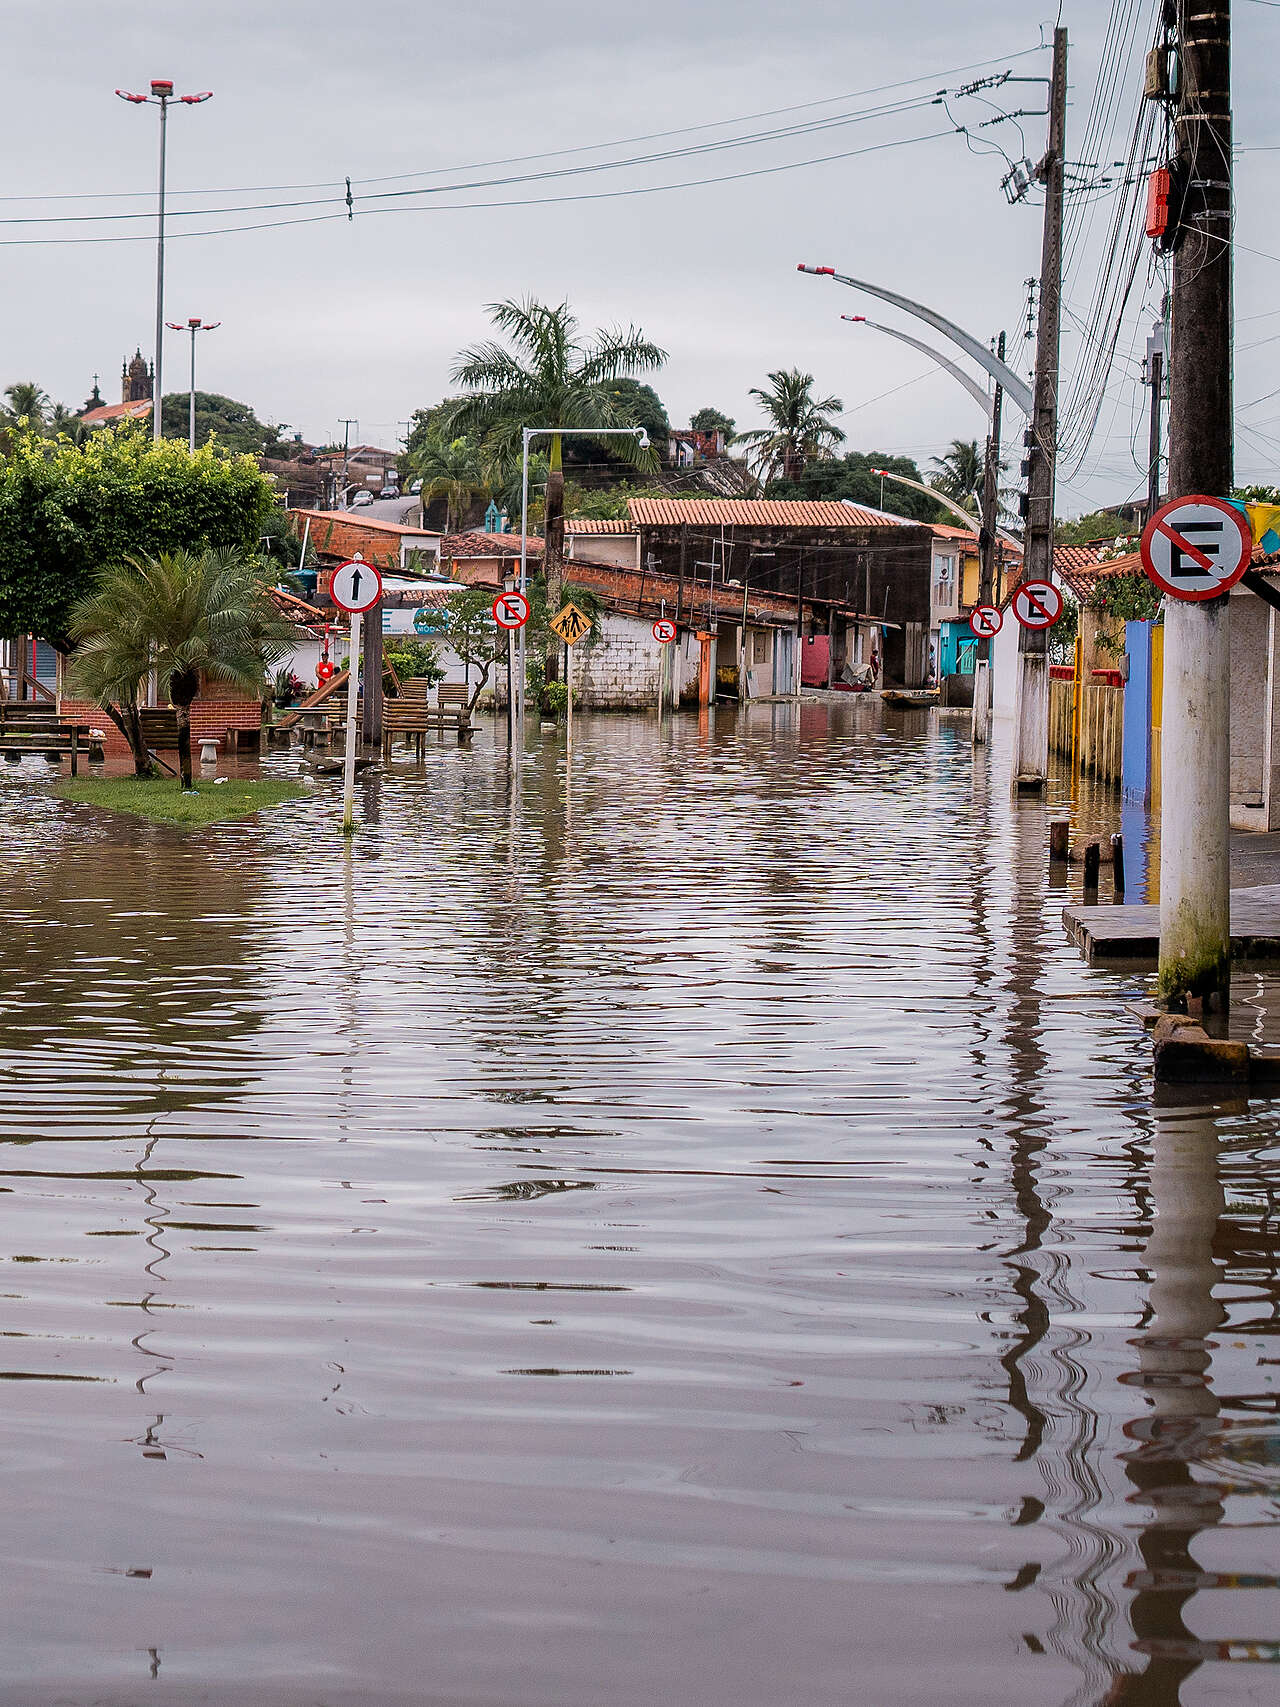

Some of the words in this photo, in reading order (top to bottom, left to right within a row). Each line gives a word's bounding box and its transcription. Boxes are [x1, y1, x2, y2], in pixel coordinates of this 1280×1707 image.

[1171, 522, 1223, 577] E
[505, 600, 519, 620] E
[1028, 590, 1047, 618] E
[980, 612, 993, 630] E
[659, 626, 670, 638] E
